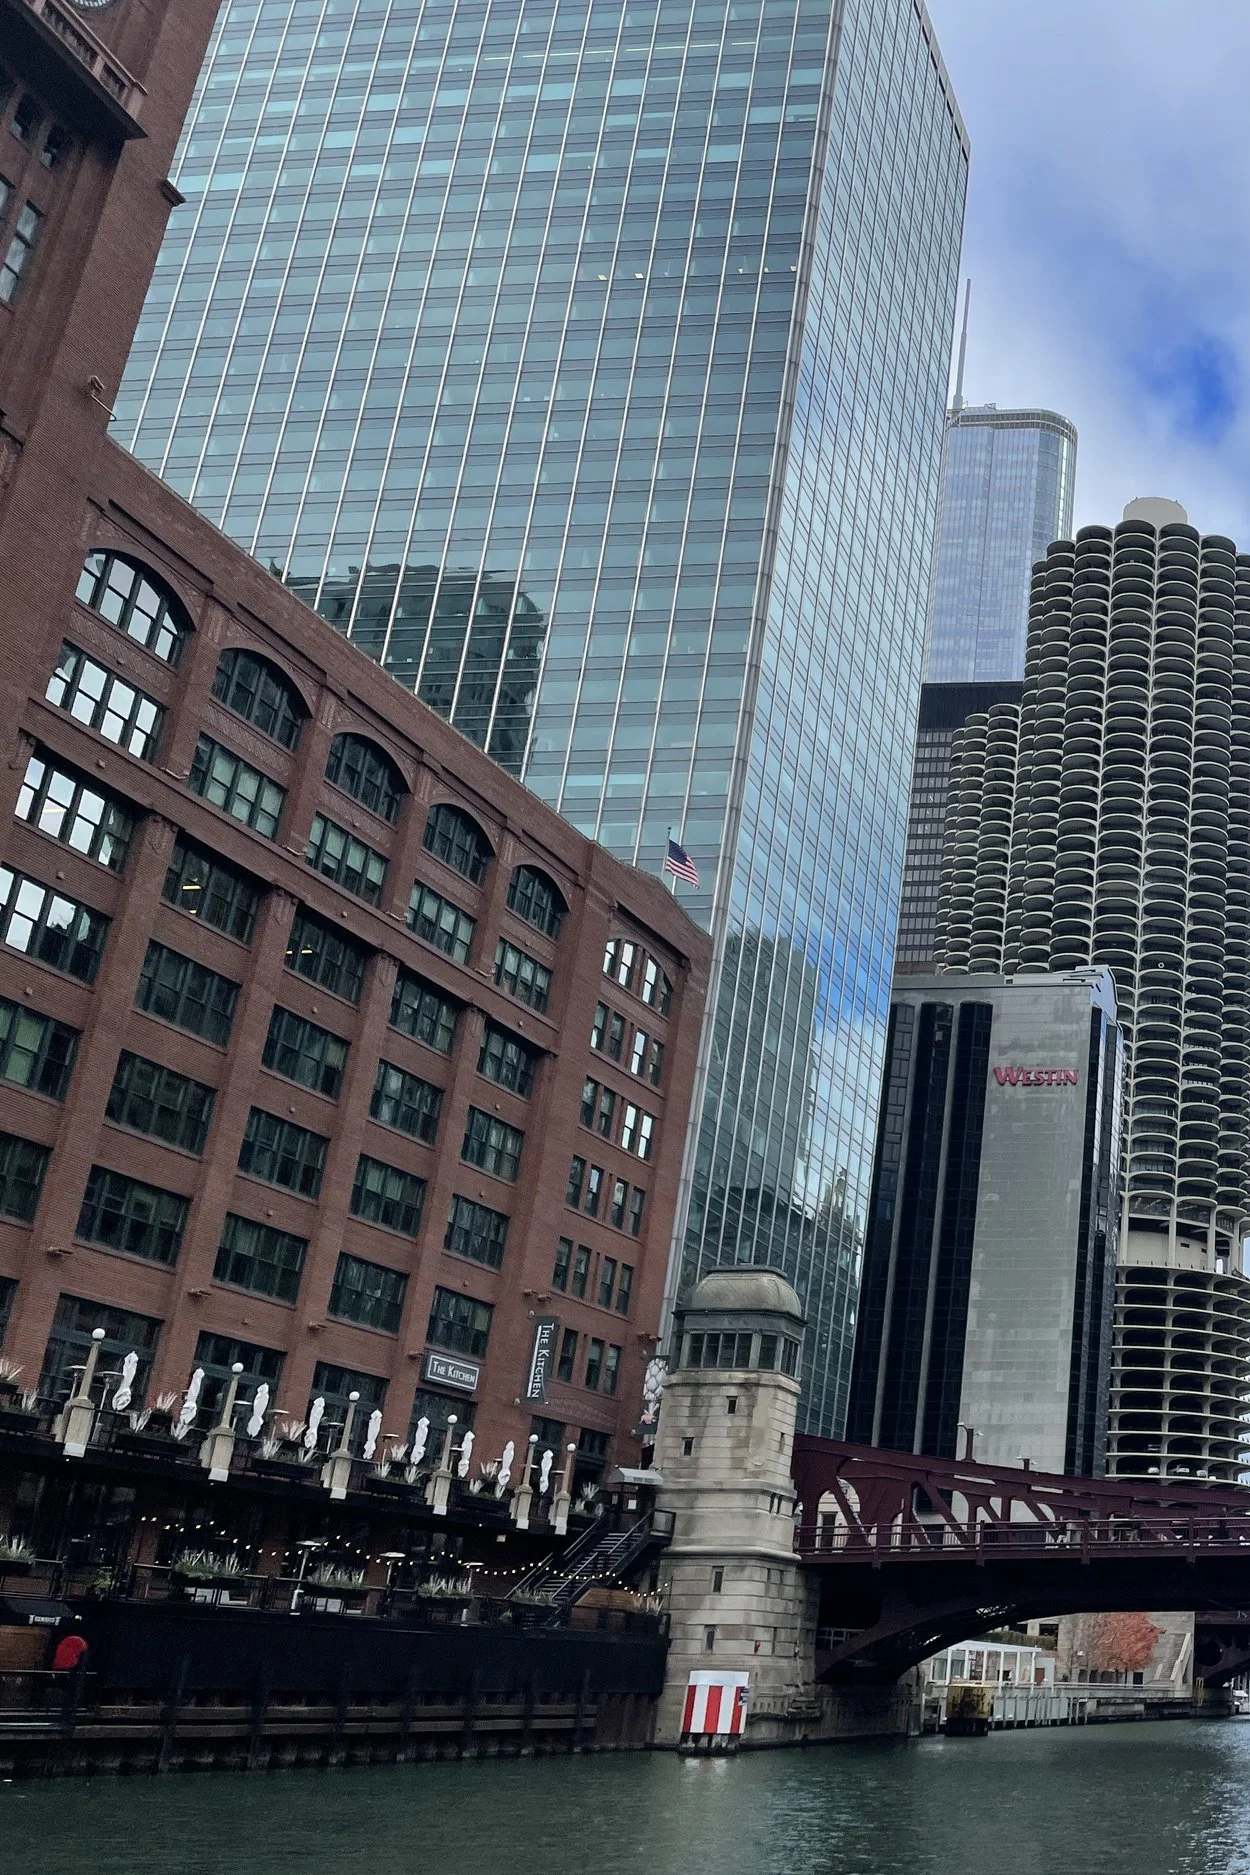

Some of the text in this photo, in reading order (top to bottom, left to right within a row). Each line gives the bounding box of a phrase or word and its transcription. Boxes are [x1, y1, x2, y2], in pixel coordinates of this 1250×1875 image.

[993, 1066, 1079, 1086] WESTIN
[531, 1323, 555, 1398] THE KITCHEN
[433, 1361, 476, 1384] THE KITCHEN
